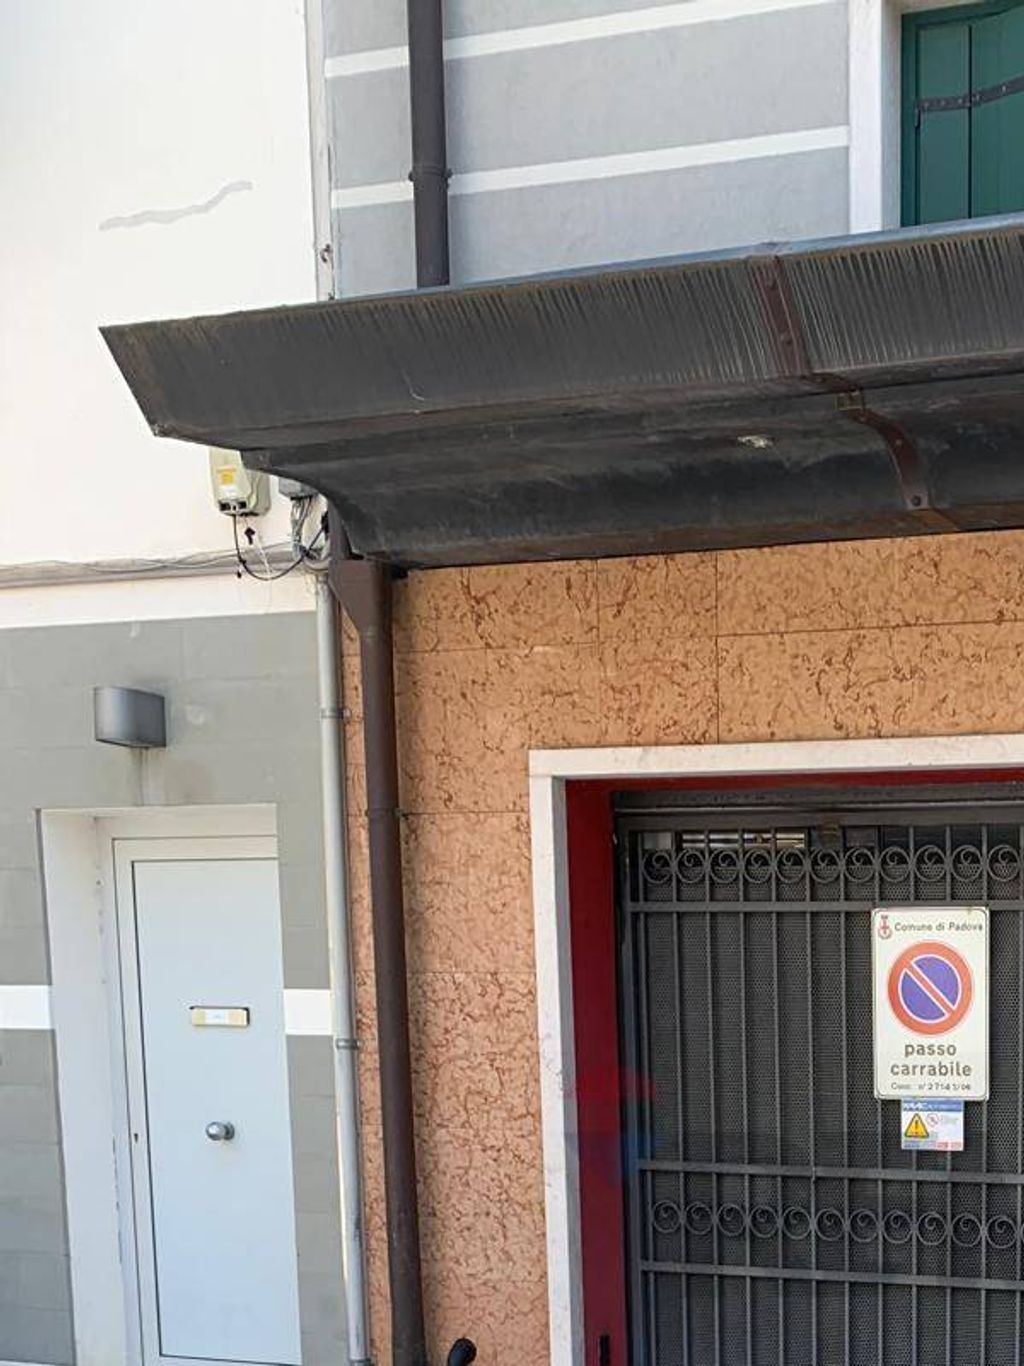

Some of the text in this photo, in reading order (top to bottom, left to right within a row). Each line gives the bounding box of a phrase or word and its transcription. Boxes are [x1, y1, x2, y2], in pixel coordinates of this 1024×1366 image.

[894, 922, 983, 931] Comune di Padova
[904, 1044, 957, 1058] passo
[890, 1061, 972, 1077] carrabile
